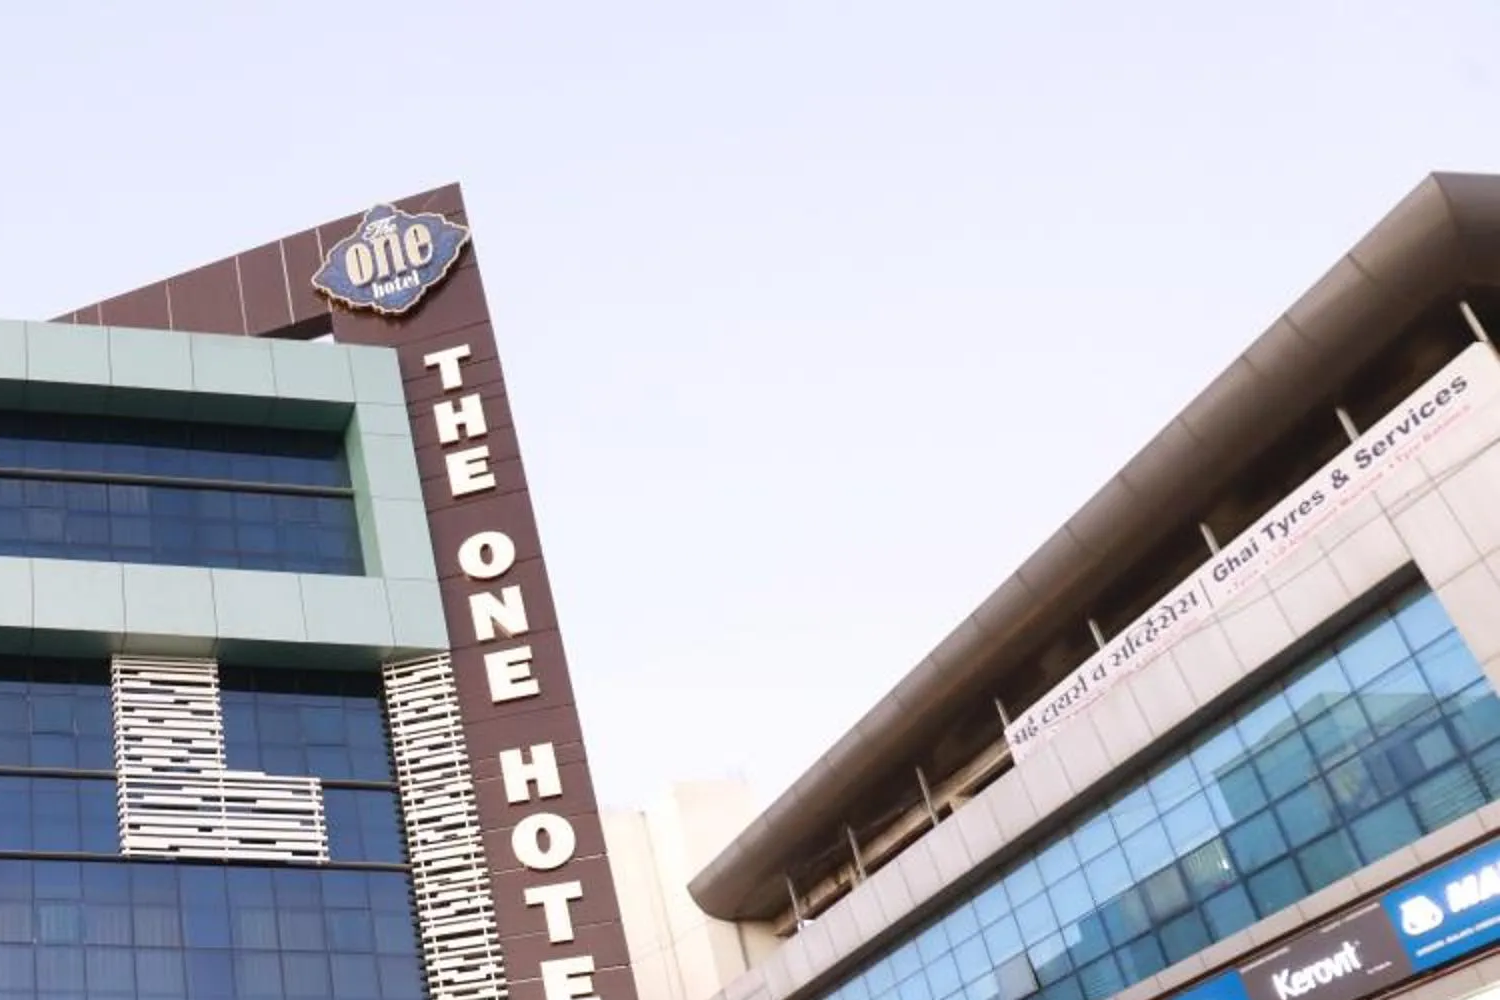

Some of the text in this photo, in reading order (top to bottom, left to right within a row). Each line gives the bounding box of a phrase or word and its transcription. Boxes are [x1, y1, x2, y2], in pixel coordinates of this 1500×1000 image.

[345, 223, 433, 287] one
[371, 269, 420, 298] hotel
[424, 344, 497, 499] THE
[1212, 538, 1260, 583] Ghai
[1261, 488, 1325, 543] Tyres
[1329, 468, 1350, 490] &
[1353, 375, 1468, 470] Services
[458, 531, 541, 703] ONE
[1445, 859, 1500, 912] MA
[1271, 941, 1362, 1000] Kerovit
